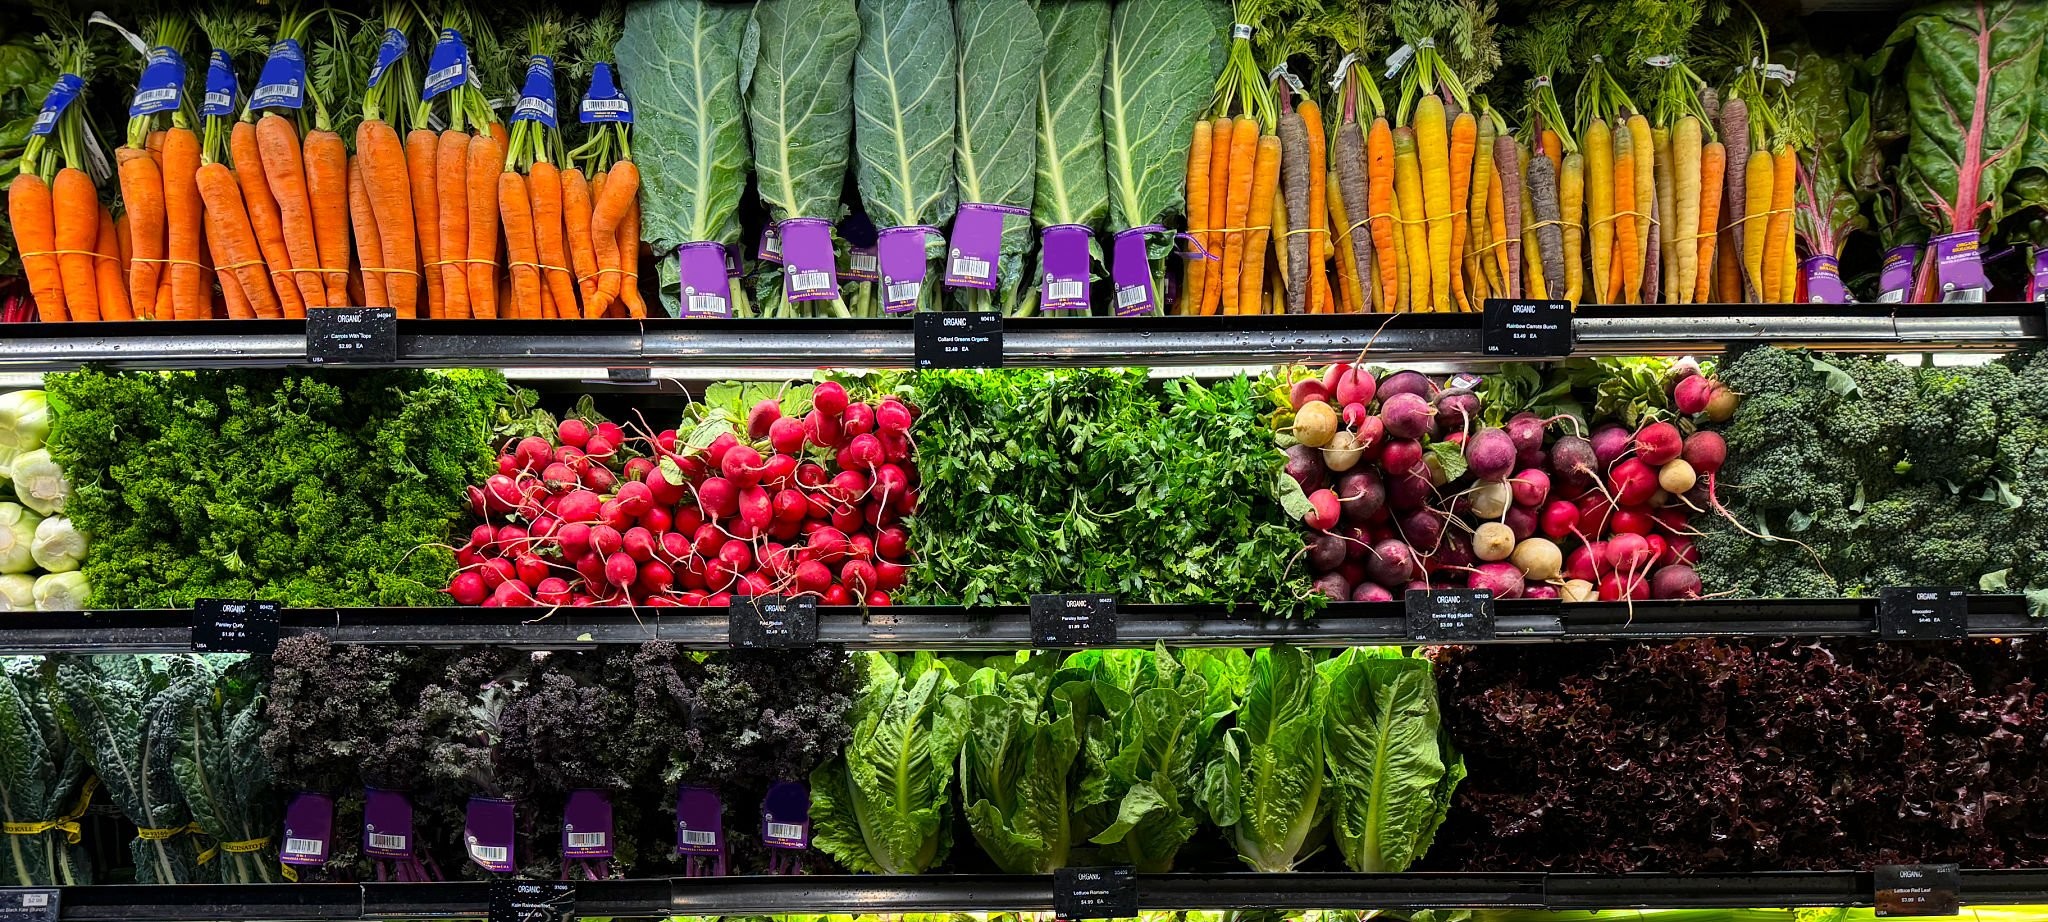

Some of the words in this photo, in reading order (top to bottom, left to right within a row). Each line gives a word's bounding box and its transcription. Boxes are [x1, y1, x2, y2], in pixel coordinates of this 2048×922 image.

[1512, 304, 1536, 314] ORGANIC
[337, 314, 362, 323] ORGANIC
[943, 317, 967, 326] ORGANIC
[1436, 595, 1461, 604] ORGANIC
[1916, 592, 1938, 600] ORGANIC
[764, 604, 787, 612] ORGANIC
[1066, 600, 1087, 608] ORGANIC
[222, 604, 246, 613] ORGANIC
[1078, 873, 1101, 881] ORGANIC
[1899, 870, 1923, 878] ORGANIC
[517, 885, 541, 893] ORGANIC
